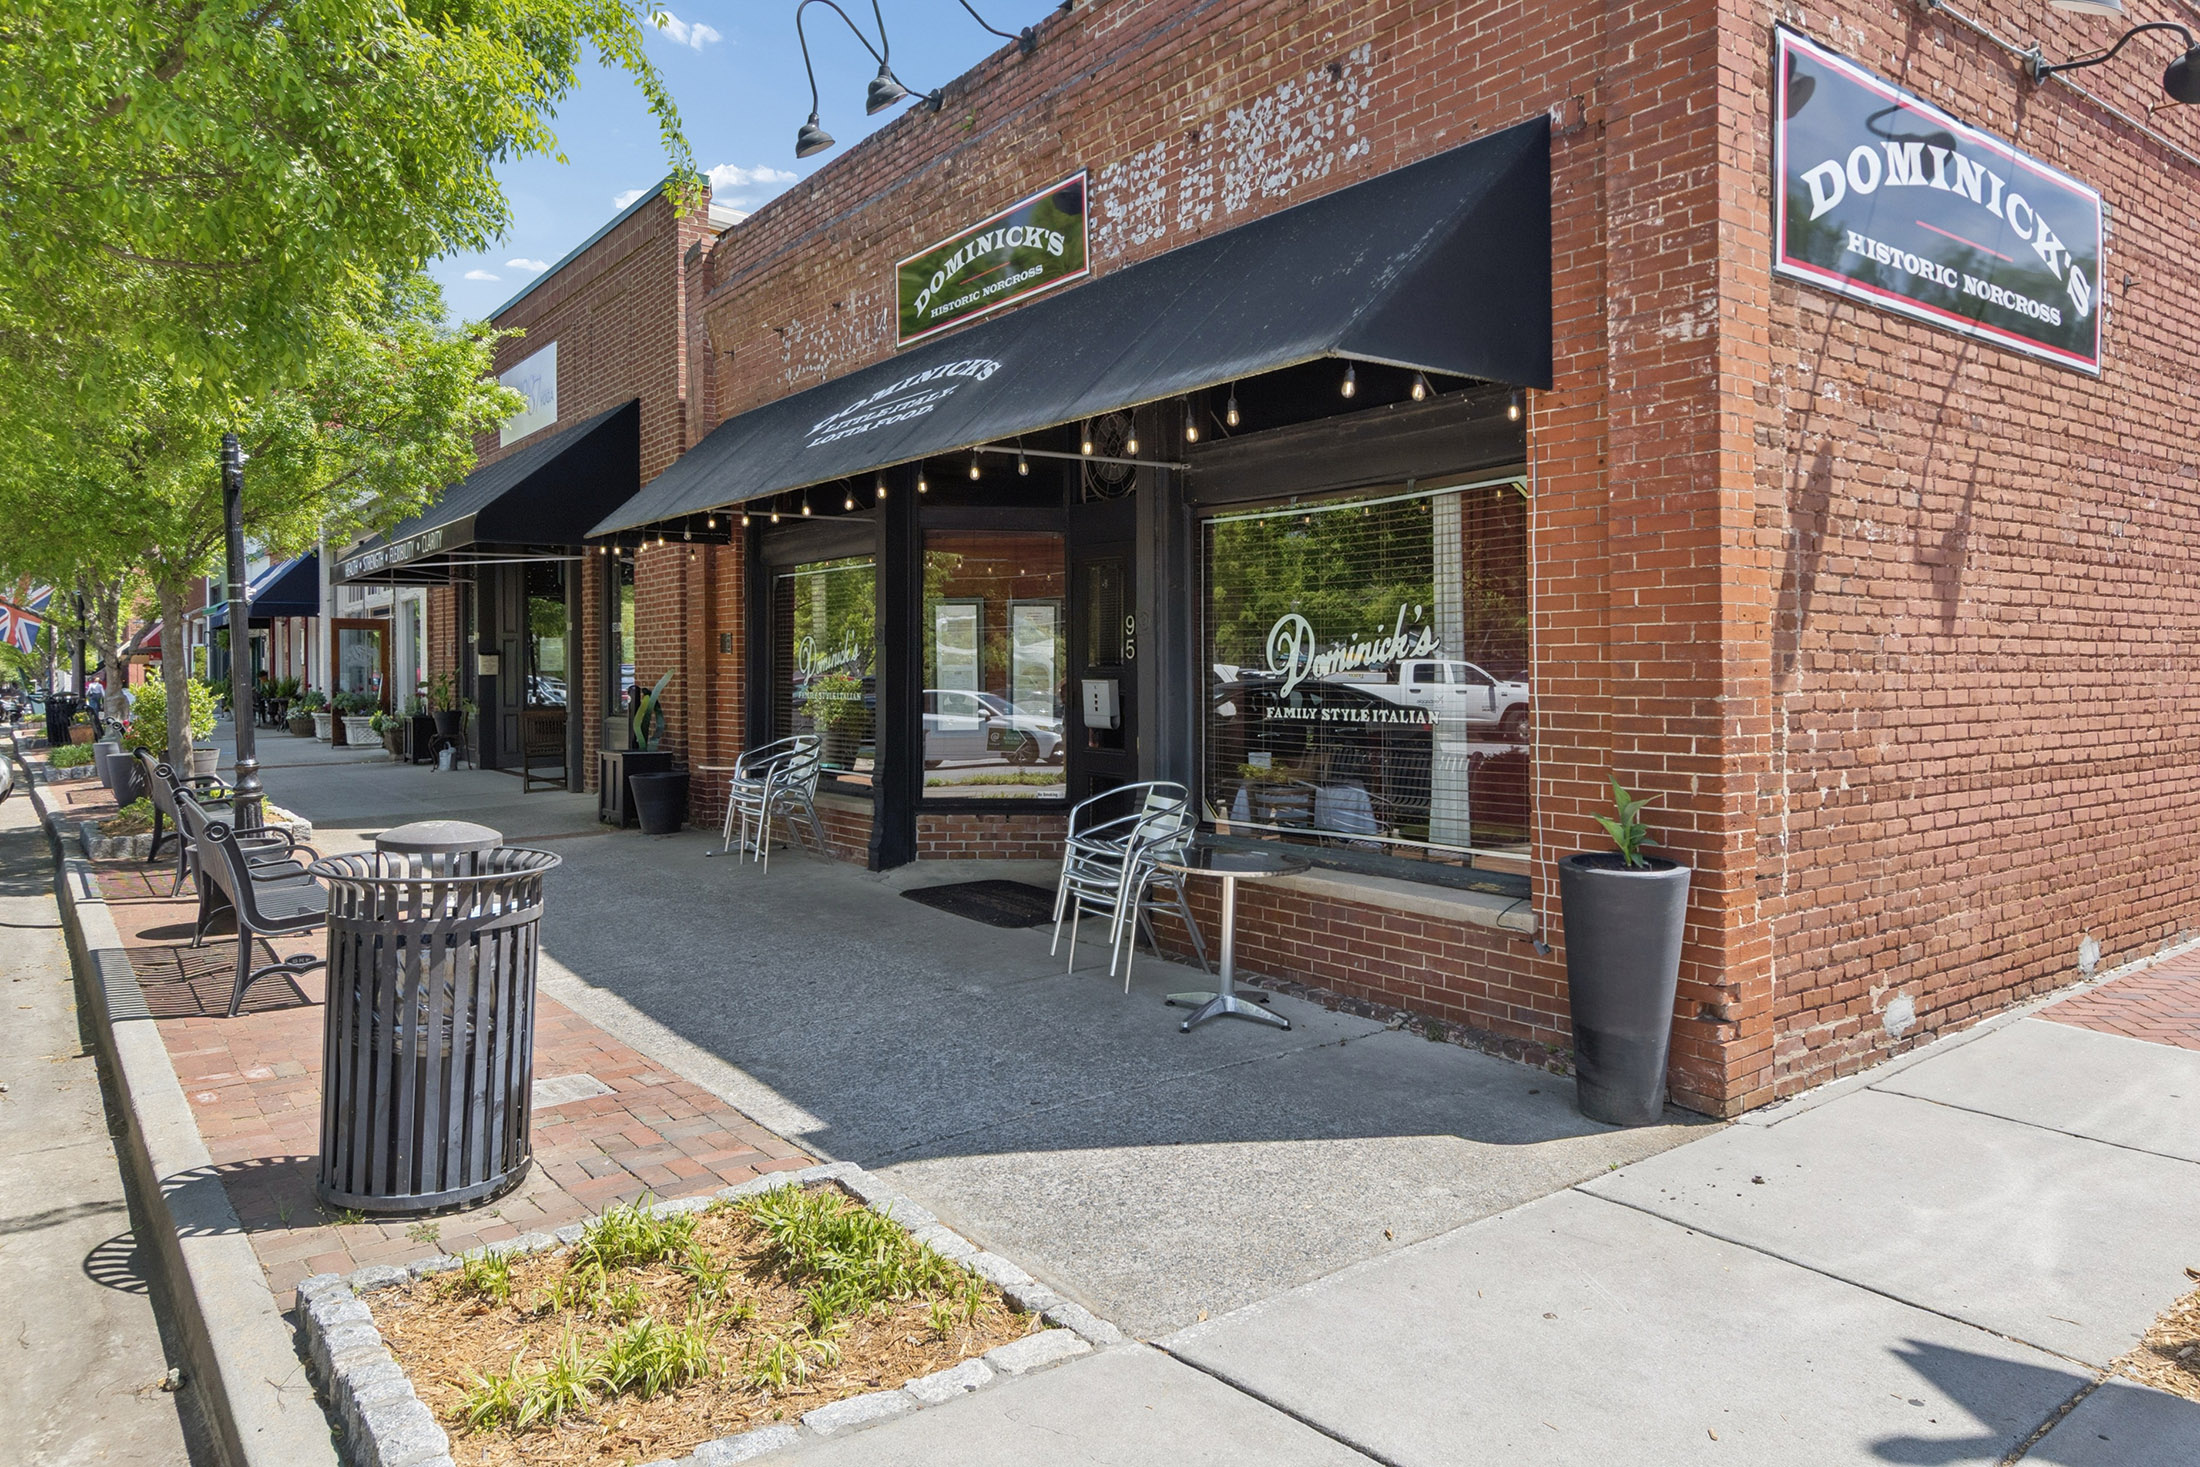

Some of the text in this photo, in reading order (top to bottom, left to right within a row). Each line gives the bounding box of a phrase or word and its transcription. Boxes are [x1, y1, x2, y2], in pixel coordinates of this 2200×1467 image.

[1800, 141, 2092, 317] DOMINICK'S
[913, 225, 1065, 318] DOMINICK'S
[930, 264, 1043, 319] HISTORIC NORCROSS
[1846, 229, 2062, 327] HISTORIC NORCROSS
[804, 359, 1002, 438] DOMINICK'S
[821, 406, 892, 434] LITTLE
[806, 422, 873, 449] LOTTA
[389, 540, 415, 564] FLEXIBILITY
[421, 529, 443, 554] CLARITY
[799, 629, 861, 686] Dominick's
[1266, 603, 1441, 698] Dominick's
[1266, 707, 1441, 725] FAMILY STYLE ITALIAN
